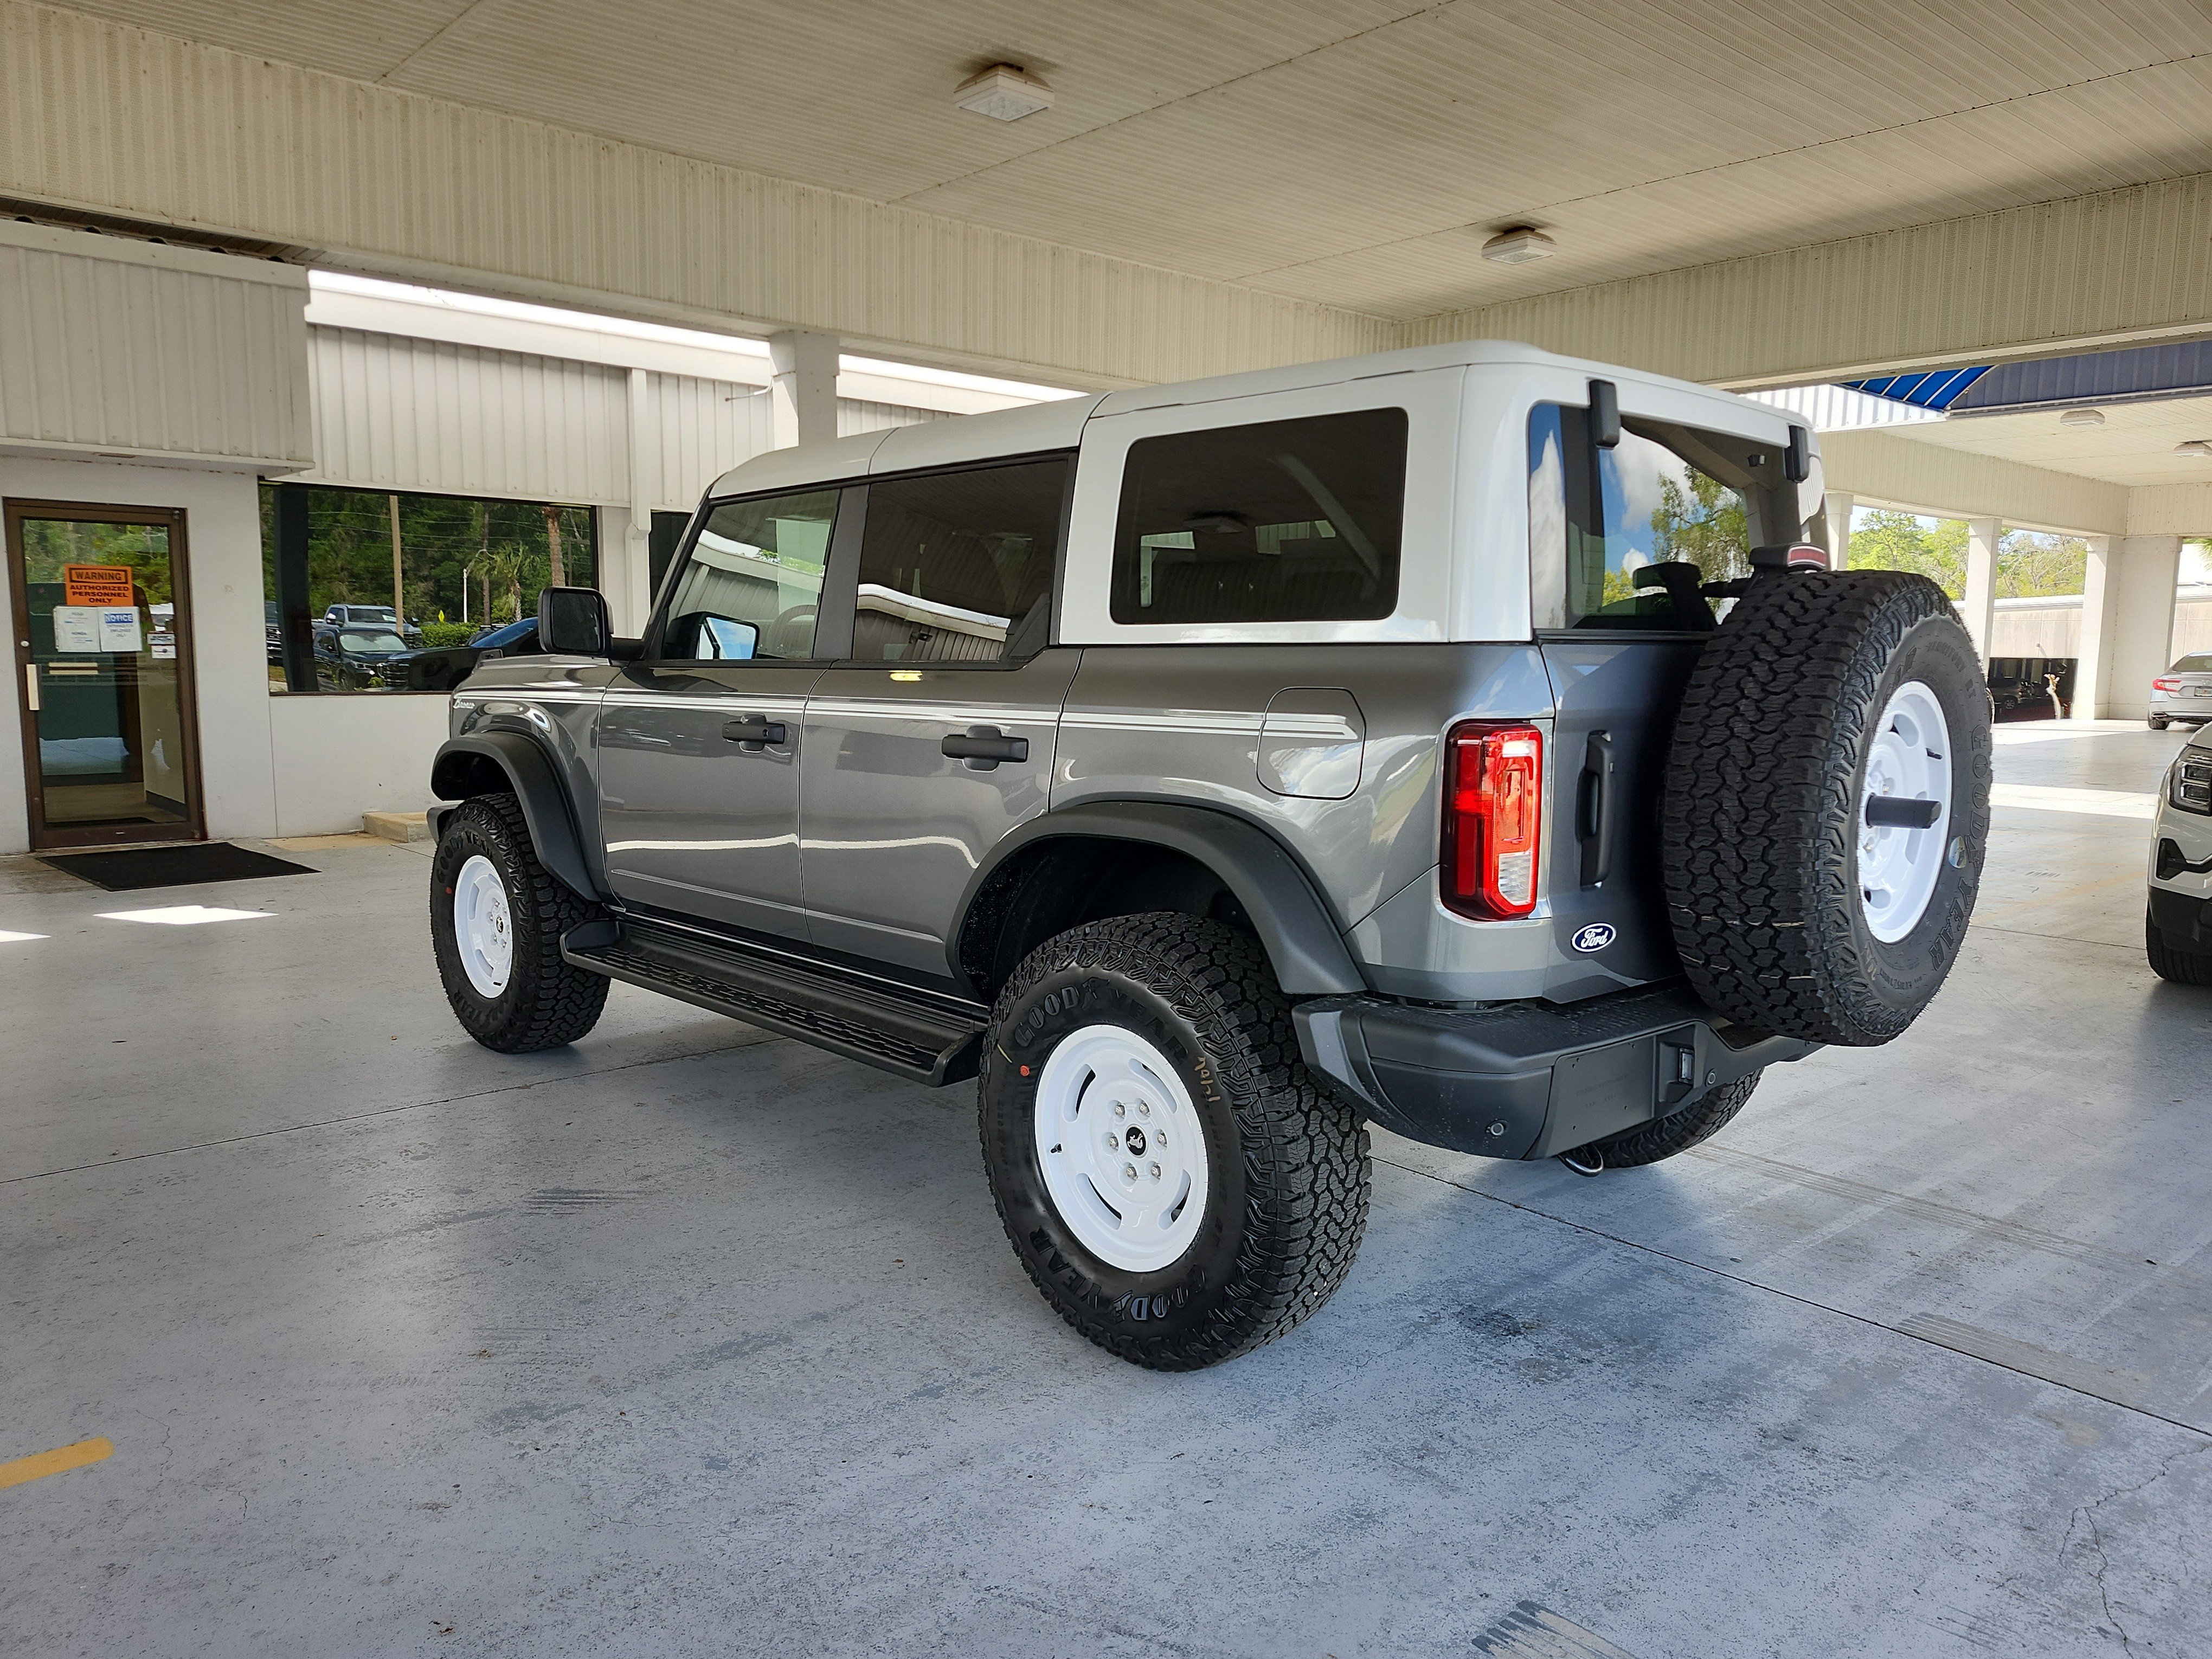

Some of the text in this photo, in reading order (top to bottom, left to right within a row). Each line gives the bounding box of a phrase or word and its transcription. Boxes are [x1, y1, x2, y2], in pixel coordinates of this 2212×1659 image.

[75, 571, 123, 581] WARNING
[105, 614, 133, 622] NOTICE
[1580, 927, 1609, 948] Ford
